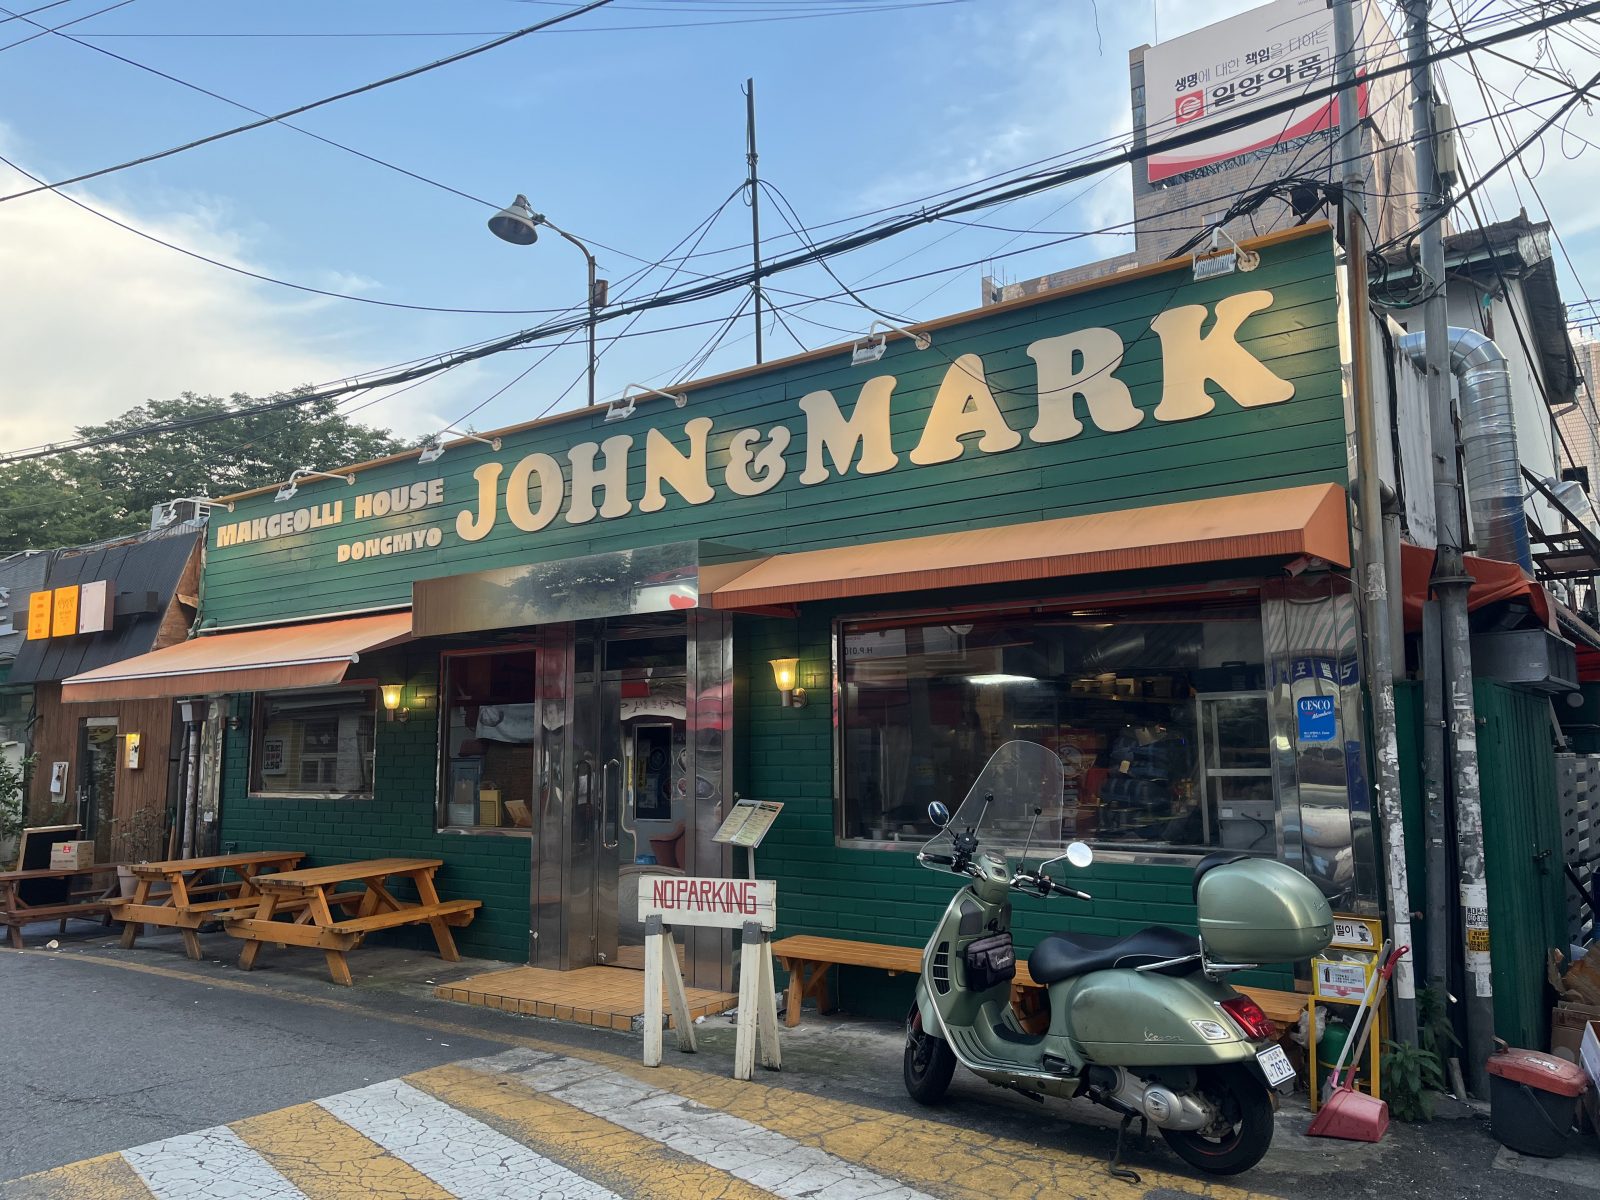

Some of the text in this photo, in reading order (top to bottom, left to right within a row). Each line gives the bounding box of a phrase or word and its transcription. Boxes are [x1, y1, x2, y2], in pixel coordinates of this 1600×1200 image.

[1175, 30, 1329, 92] 생명에 대한 책임을 다하는
[1212, 54, 1321, 108] 일양약품
[216, 478, 444, 548] MAKGEOLLI HOUSE
[337, 527, 443, 563] DONGMYO
[1300, 700, 1331, 711] CESCO
[1334, 924, 1354, 937] 떨이
